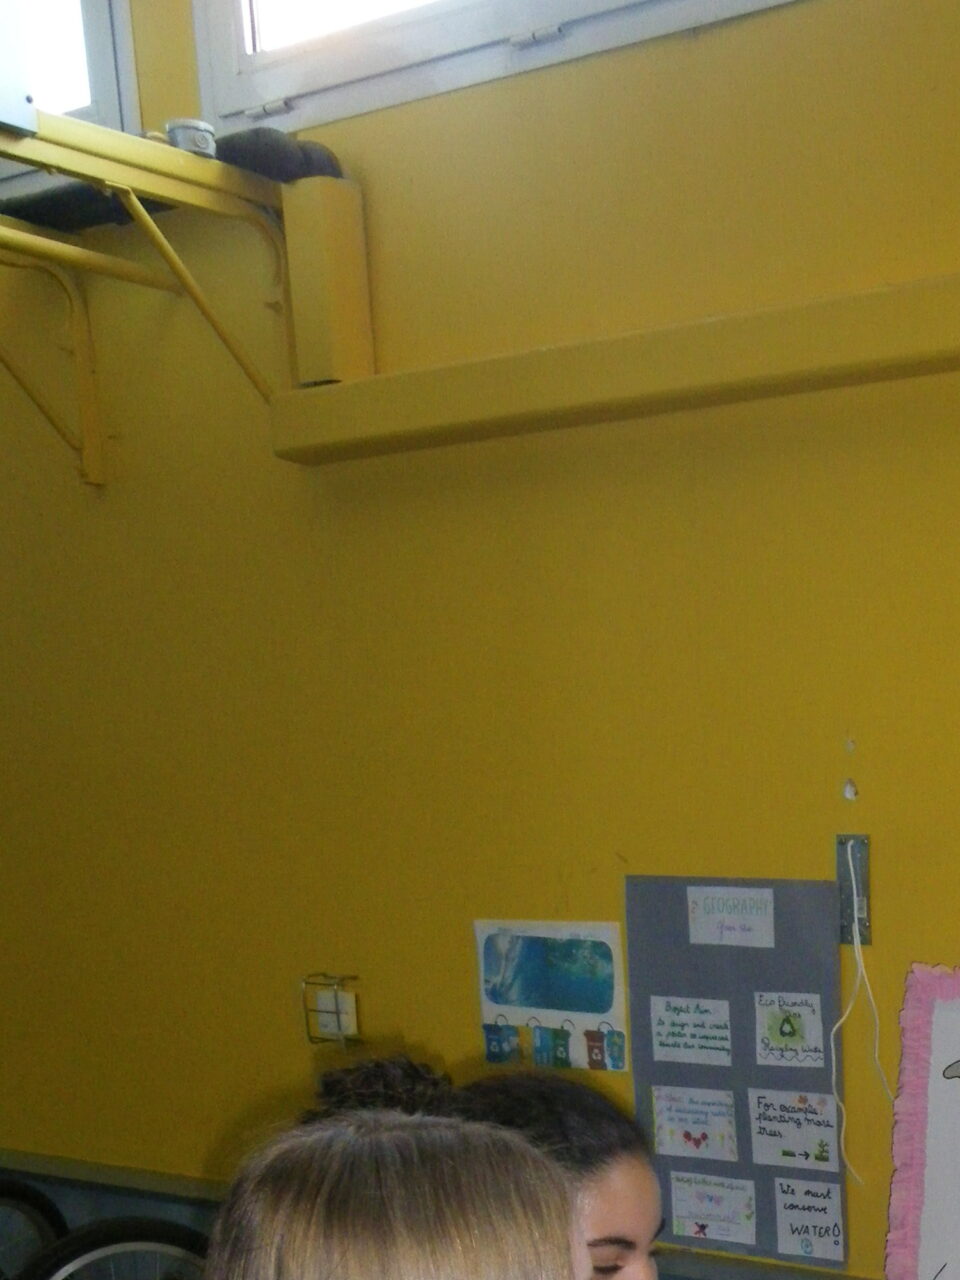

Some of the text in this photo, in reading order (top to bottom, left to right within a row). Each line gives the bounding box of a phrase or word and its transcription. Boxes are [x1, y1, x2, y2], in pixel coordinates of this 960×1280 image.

[703, 895, 768, 916] GEOGRAPHY
[756, 1095, 777, 1111] For
[755, 1112, 834, 1128] planting more
[779, 1183, 832, 1199] We must
[783, 1202, 828, 1214] conserve
